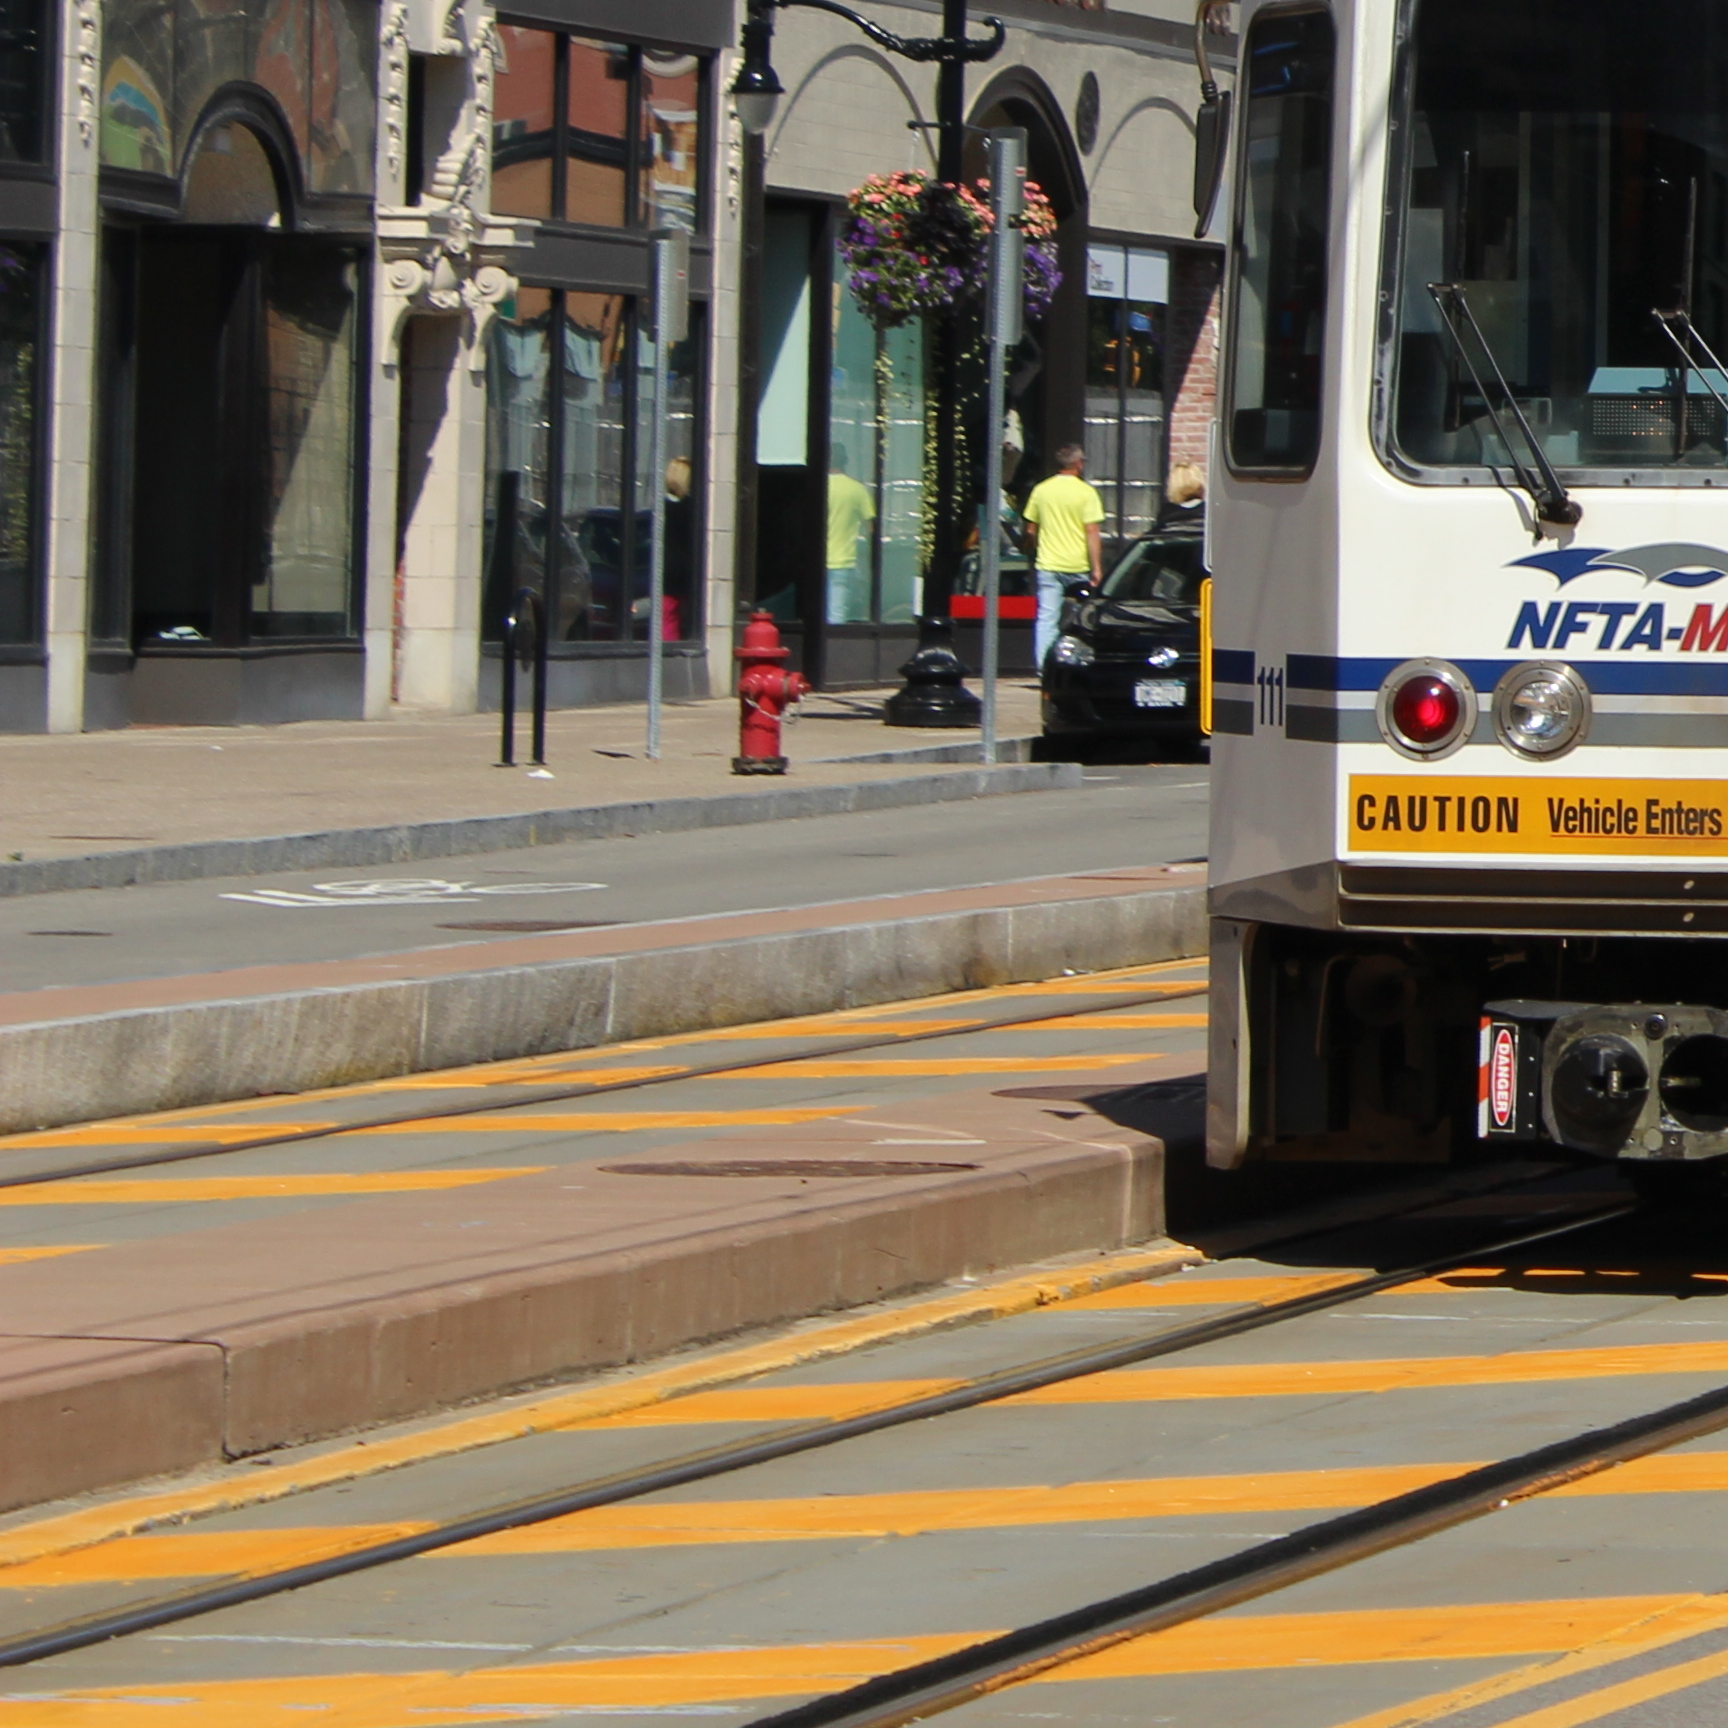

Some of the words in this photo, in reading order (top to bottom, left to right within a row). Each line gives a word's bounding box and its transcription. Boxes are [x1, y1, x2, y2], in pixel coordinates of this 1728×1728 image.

[1256, 665, 1286, 727] 111
[1356, 794, 1519, 833] CAUTION
[1547, 797, 1638, 835] Vehicle
[1645, 800, 1723, 836] Enters
[1497, 1043, 1510, 1113] DANGER
